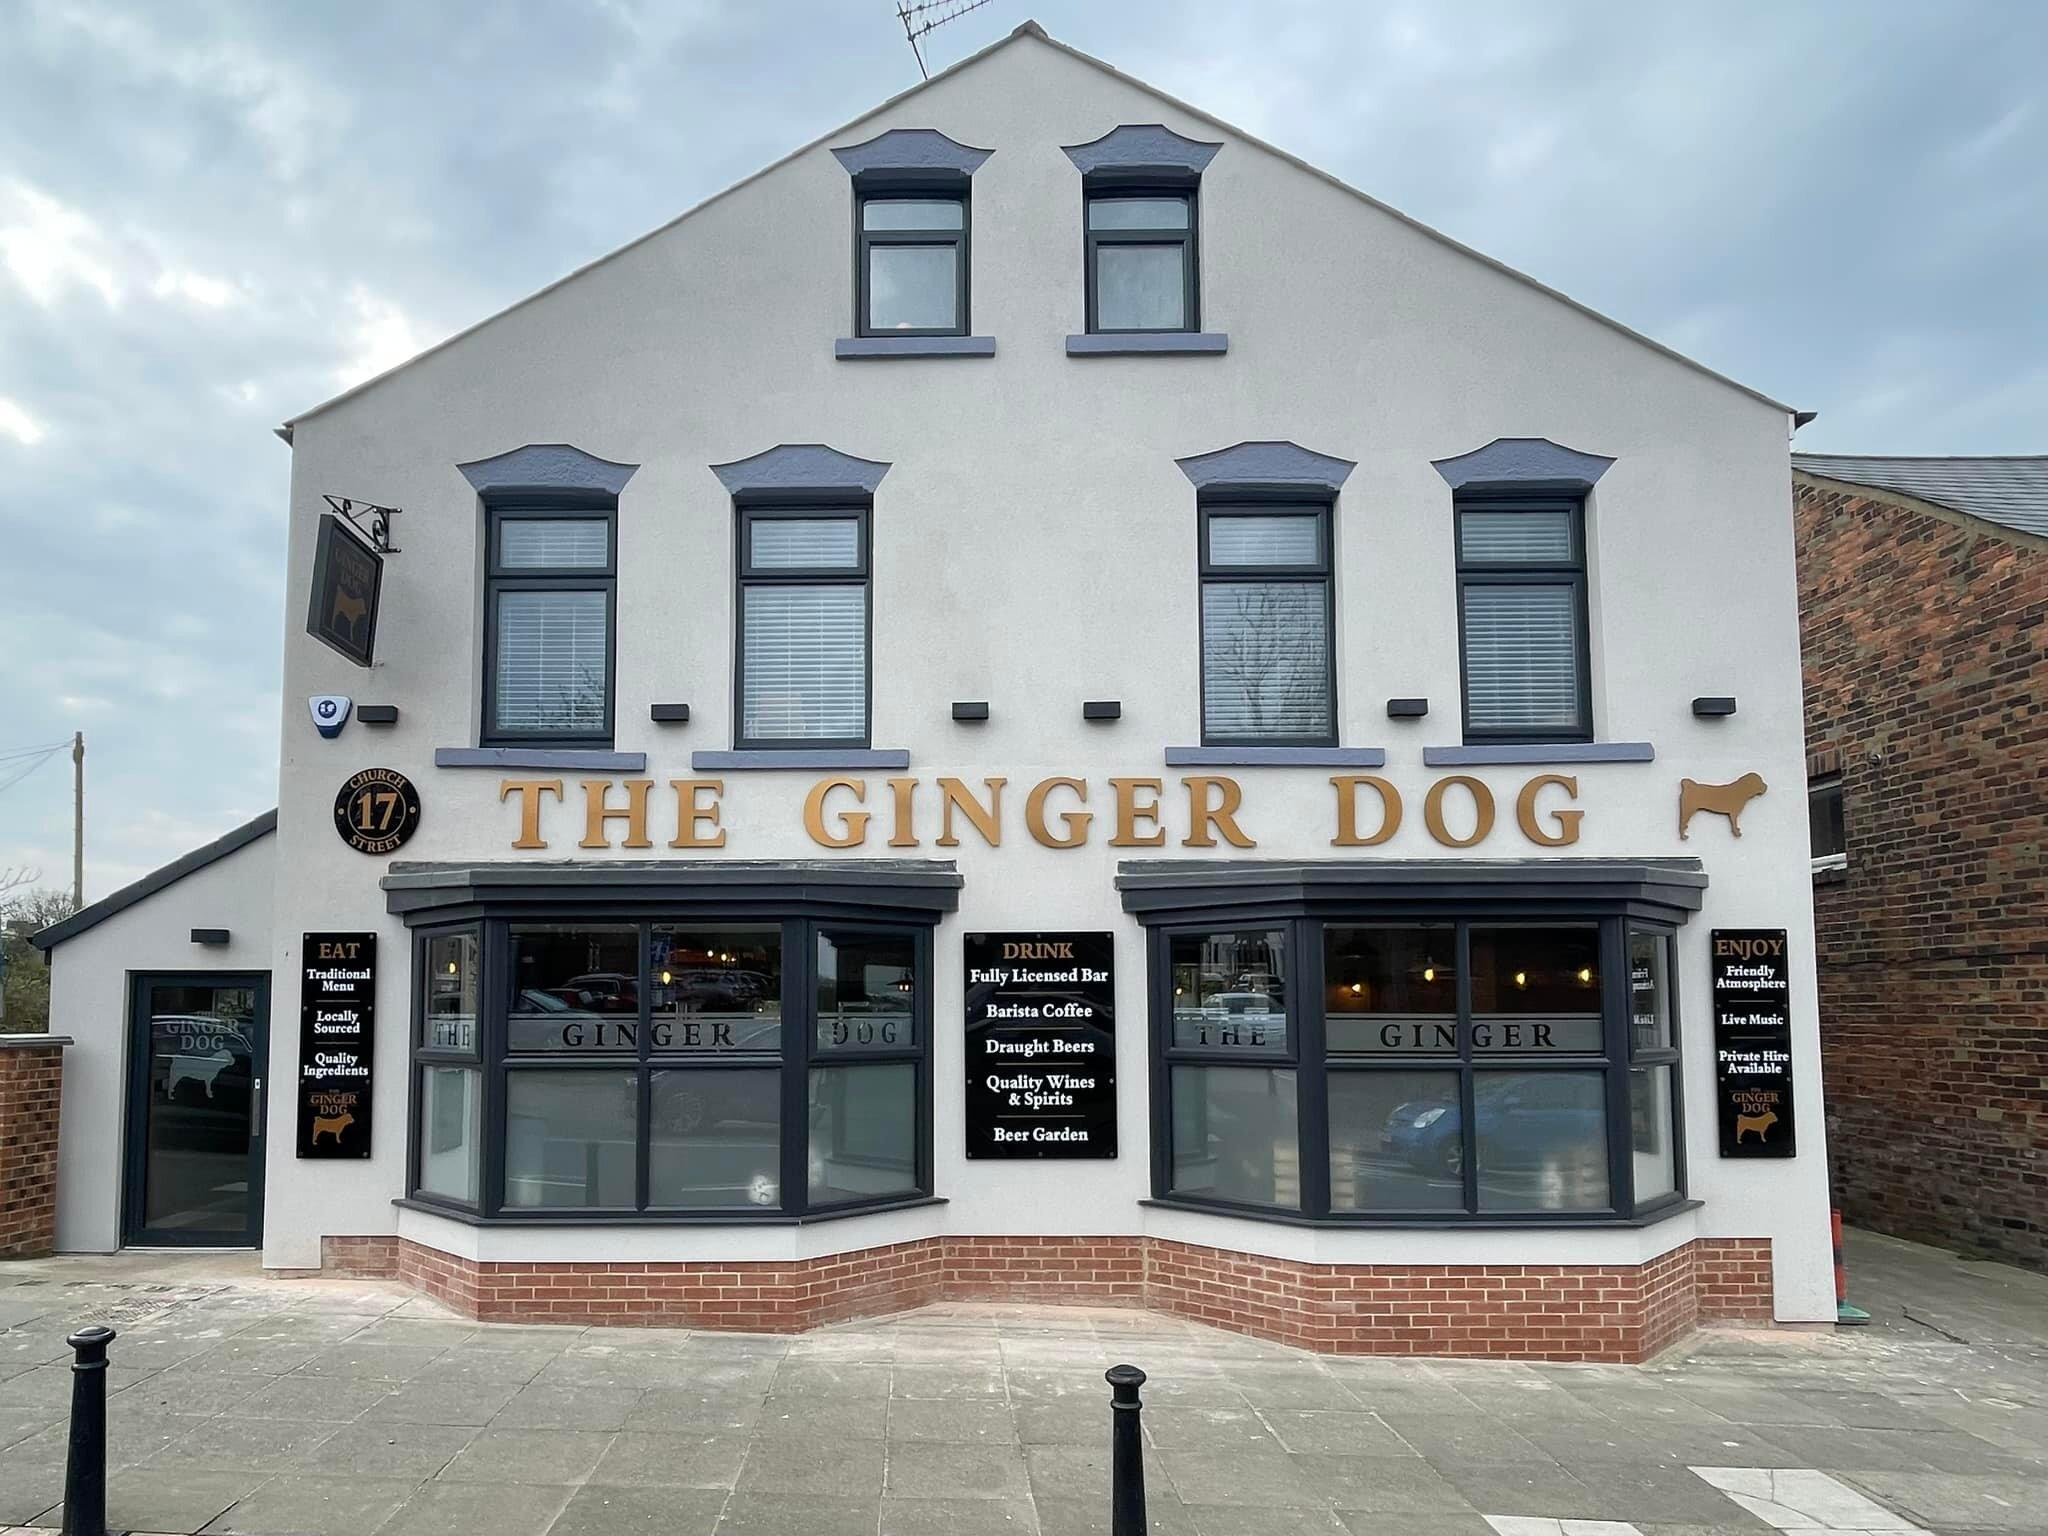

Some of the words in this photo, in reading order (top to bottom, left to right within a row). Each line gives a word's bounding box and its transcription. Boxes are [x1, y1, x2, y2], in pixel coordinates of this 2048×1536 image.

[350, 770, 407, 789] CHURCH
[357, 792, 398, 830] 17
[500, 778, 727, 848] THE
[803, 775, 1257, 849] GINGER
[1329, 774, 1585, 848] DOG
[350, 834, 401, 853] STREET
[318, 942, 360, 959] EAT
[1003, 942, 1075, 959] DRINK
[1714, 939, 1784, 961] ENJOY
[306, 968, 371, 979] Traditional
[970, 968, 1009, 987] Fully
[1012, 968, 1078, 983] Licensed
[1081, 968, 1108, 982] Bar
[1726, 965, 1775, 979] Friendly
[322, 980, 355, 992] Menu
[1716, 978, 1787, 991] Atmosphere
[316, 1010, 359, 1024] Locally
[986, 1004, 1039, 1018] Barista
[1042, 1003, 1093, 1018] Coffee
[166, 1018, 241, 1034] GINGER
[1721, 1014, 1747, 1025] Live
[1749, 1014, 1784, 1025] Music
[314, 1022, 361, 1034] Sourced
[435, 1023, 471, 1047] THE
[562, 1023, 735, 1047] GINGER
[832, 1021, 897, 1045] DOG
[1195, 1023, 1266, 1046] THE
[1380, 1023, 1556, 1048] GINGER
[180, 1035, 225, 1050] DOG
[986, 1039, 1050, 1057] Draught
[1052, 1039, 1095, 1054] Beers
[315, 1052, 359, 1067] Quality
[1719, 1050, 1761, 1062] Private
[1763, 1050, 1789, 1062] Hire
[303, 1065, 369, 1079] Ingredients
[1728, 1062, 1782, 1074] Available
[986, 1075, 1043, 1093] Quality
[1046, 1075, 1095, 1089] Wines
[311, 1094, 357, 1104] GINGER
[1008, 1093, 1021, 1106] &
[1024, 1091, 1073, 1110] Spirits
[1732, 1092, 1779, 1103] GINGER
[320, 1104, 348, 1114] DOG
[1742, 1103, 1771, 1113] DOG
[994, 1127, 1030, 1142] Beer
[1033, 1127, 1089, 1142] Garden
